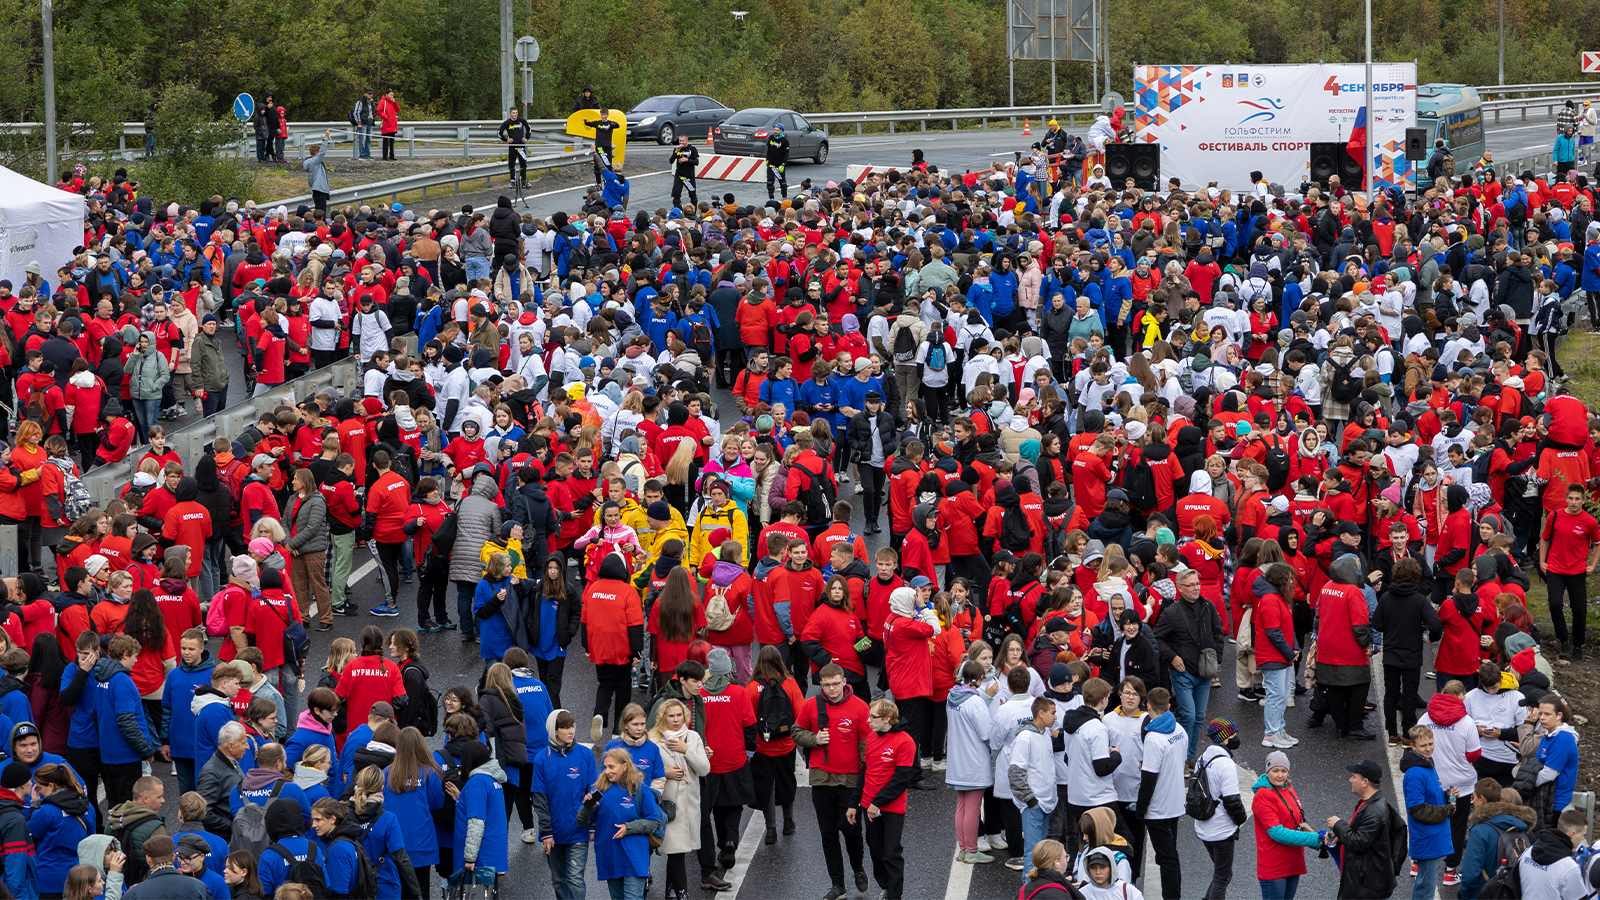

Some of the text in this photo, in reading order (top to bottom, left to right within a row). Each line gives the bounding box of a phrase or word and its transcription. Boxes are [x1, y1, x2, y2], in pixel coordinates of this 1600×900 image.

[1341, 83, 1404, 92] СЕНЯБРЯ
[1198, 142, 1268, 151] ФЕСТИВАЛЬ
[183, 513, 204, 521] МУРМАНСК
[591, 592, 617, 601] МУРМАНСК
[1321, 588, 1344, 599] МУРМАНСК
[351, 669, 389, 677] МУРМАНСК
[516, 685, 543, 694] МУРМАНСК
